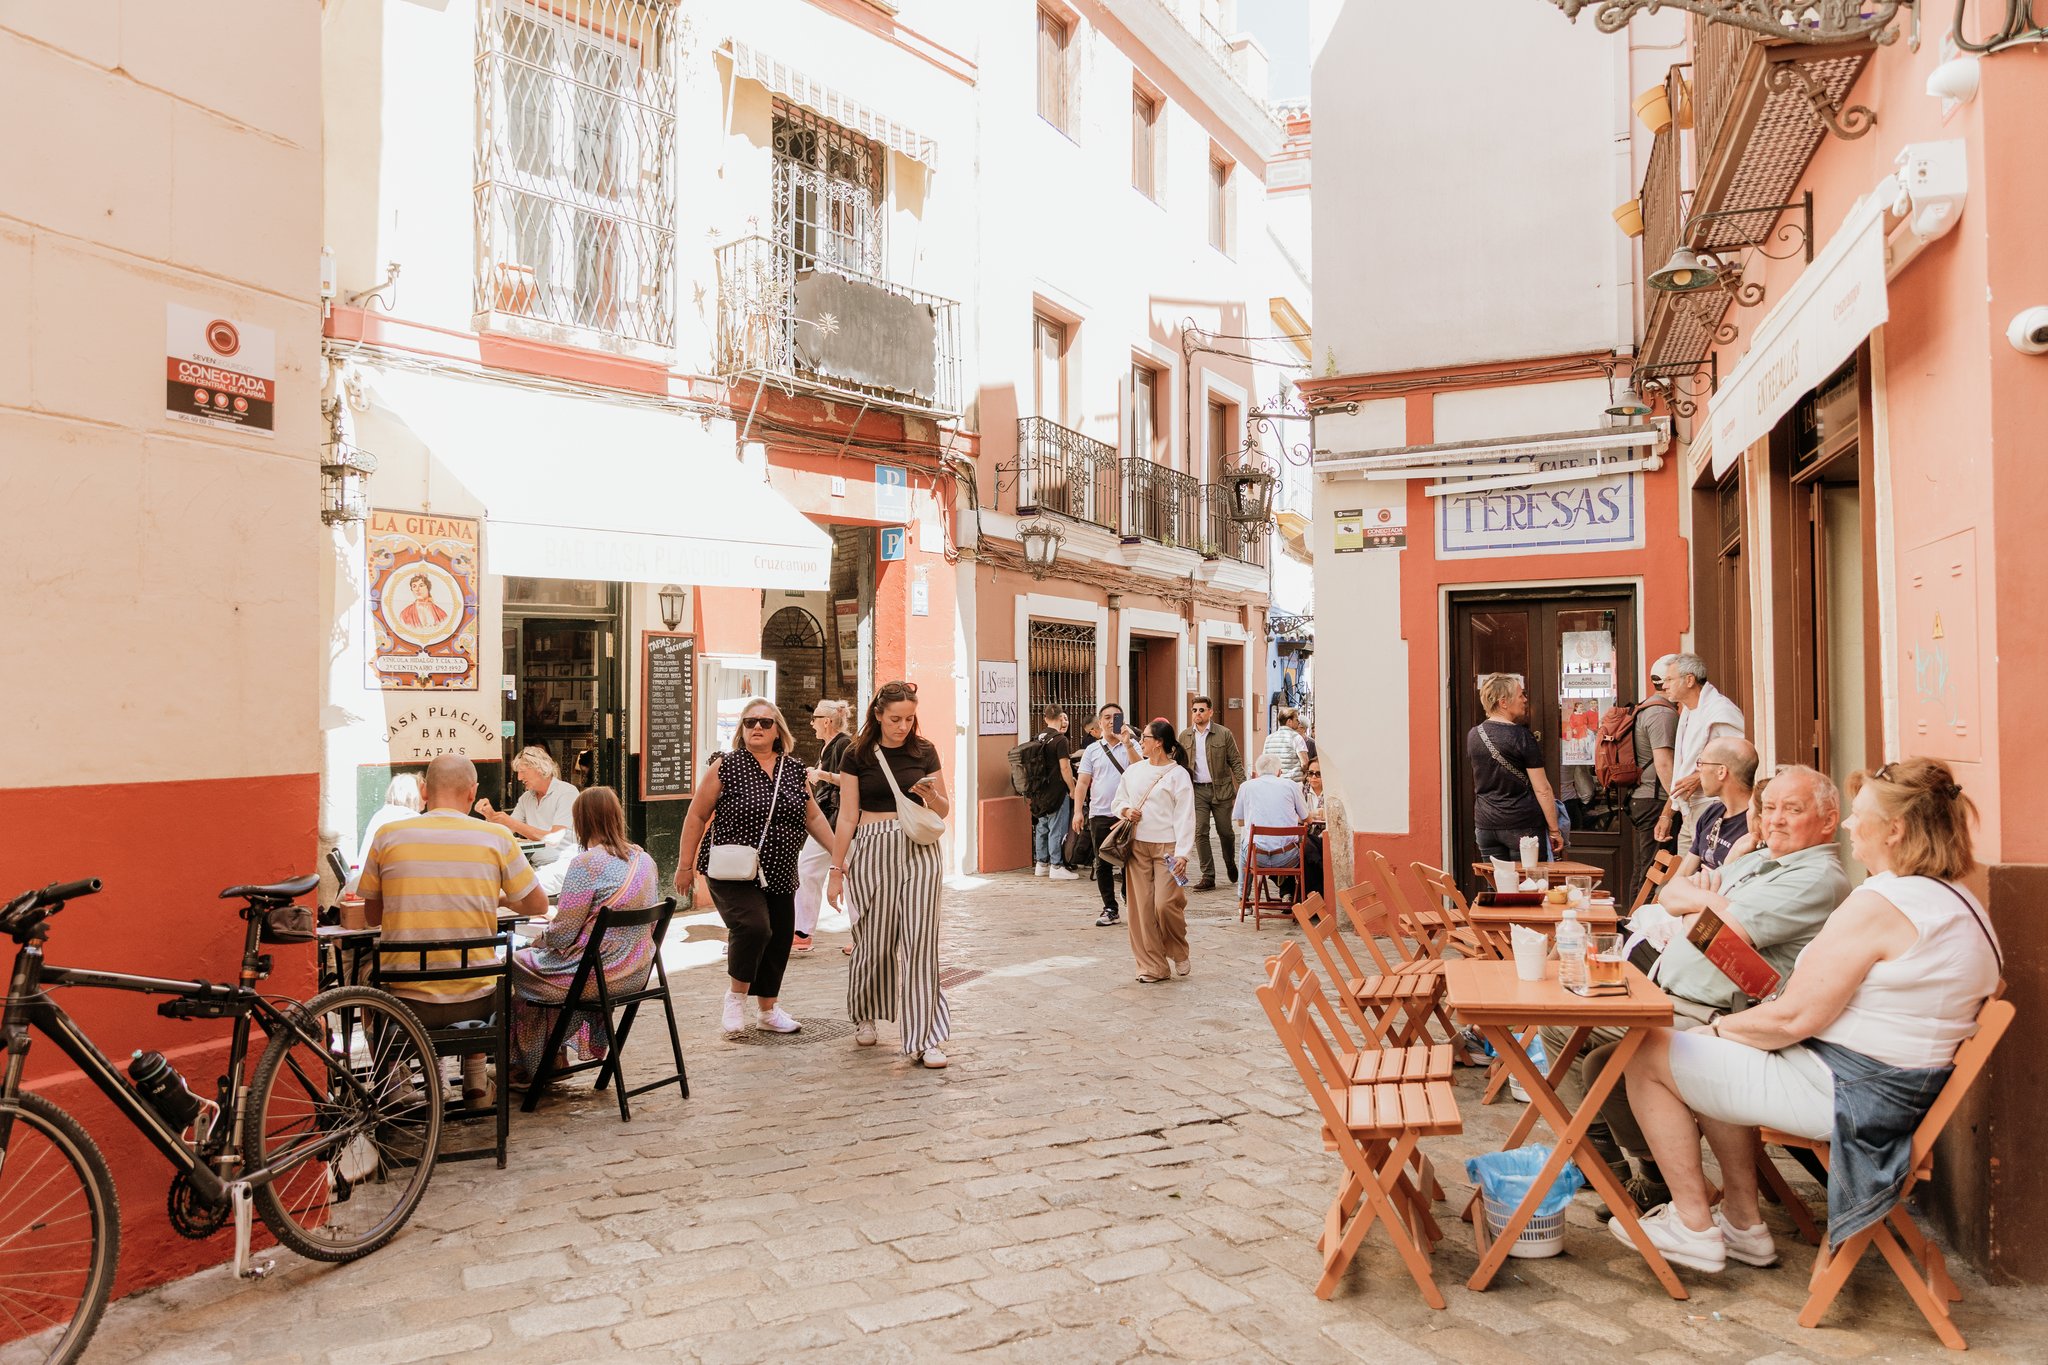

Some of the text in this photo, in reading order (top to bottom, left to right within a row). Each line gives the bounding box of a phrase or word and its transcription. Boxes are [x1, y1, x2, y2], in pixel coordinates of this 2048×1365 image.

[192, 353, 216, 364] SEVEN
[178, 362, 266, 393] CONECTADA
[179, 374, 266, 399] CON CENTRAL DE ALARMA
[884, 470, 900, 497] P
[1453, 484, 1623, 534] TERESAS
[372, 513, 473, 540] LA GITANA
[544, 537, 586, 569] BAR
[593, 541, 647, 573] CASA
[886, 534, 899, 555] P
[754, 555, 817, 574] Cruzcampo
[648, 637, 671, 653] TAPAS
[665, 638, 693, 654] RACIONES
[982, 671, 997, 693] LAS
[981, 701, 1016, 725] TERESAS
[382, 707, 494, 743] CASA PLACIDO
[422, 728, 456, 738] BAR
[413, 747, 466, 757] TAPAS
